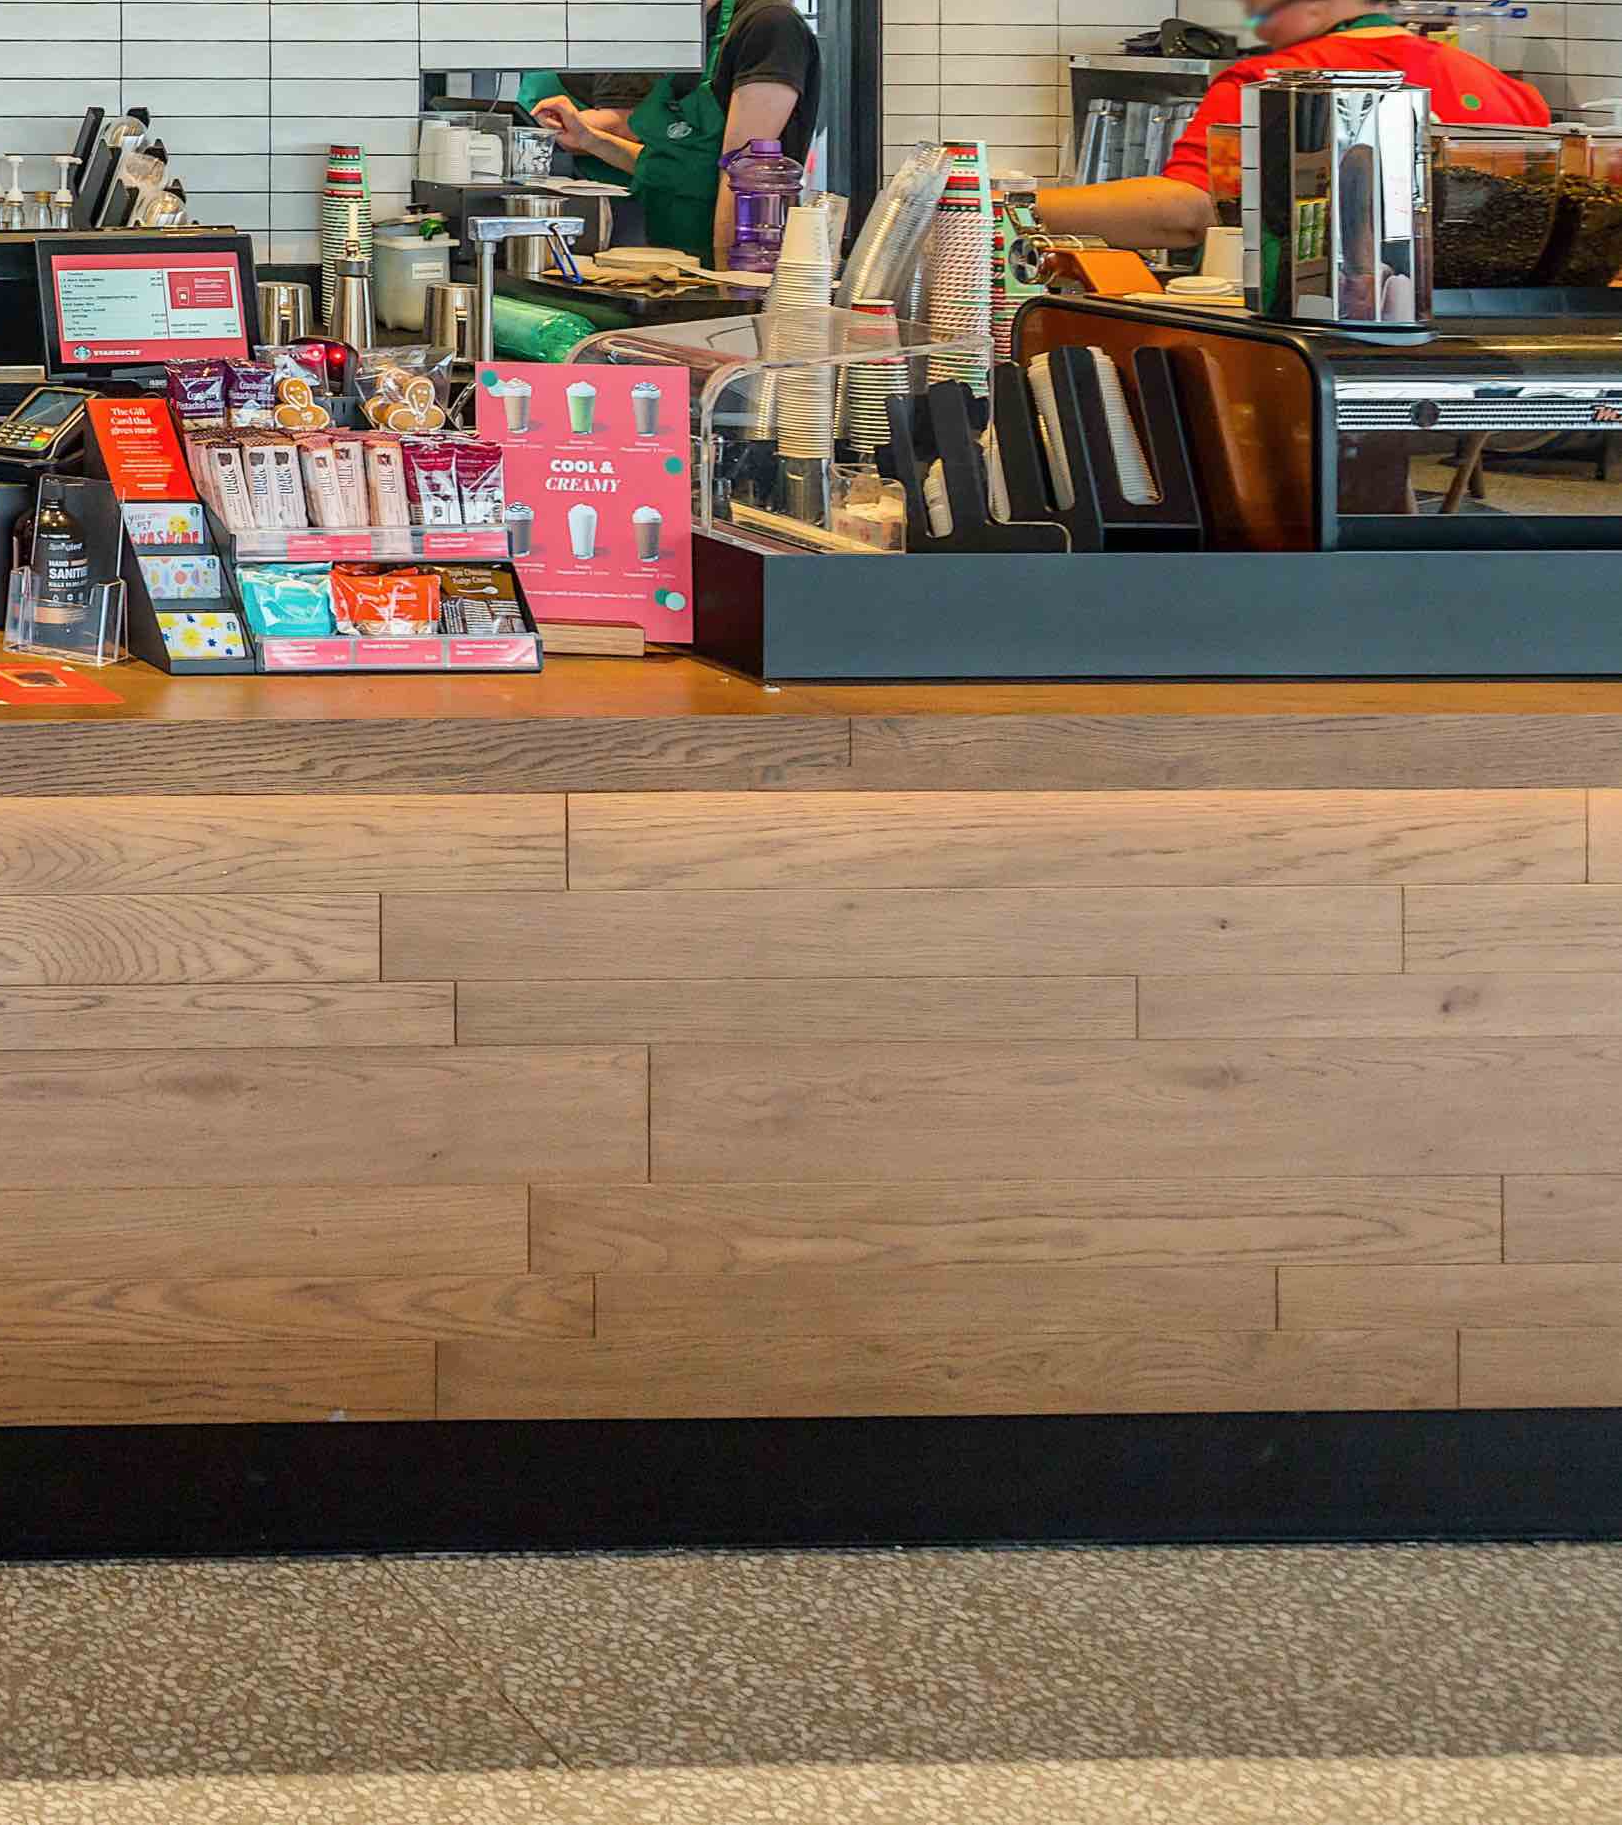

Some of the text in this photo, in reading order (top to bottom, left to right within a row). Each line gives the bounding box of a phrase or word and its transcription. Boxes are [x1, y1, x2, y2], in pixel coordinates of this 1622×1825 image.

[111, 407, 146, 416] The Gift
[111, 417, 152, 426] Card that
[110, 427, 157, 436] gives more
[550, 459, 615, 474] COOL &
[545, 477, 621, 493] CREAMY
